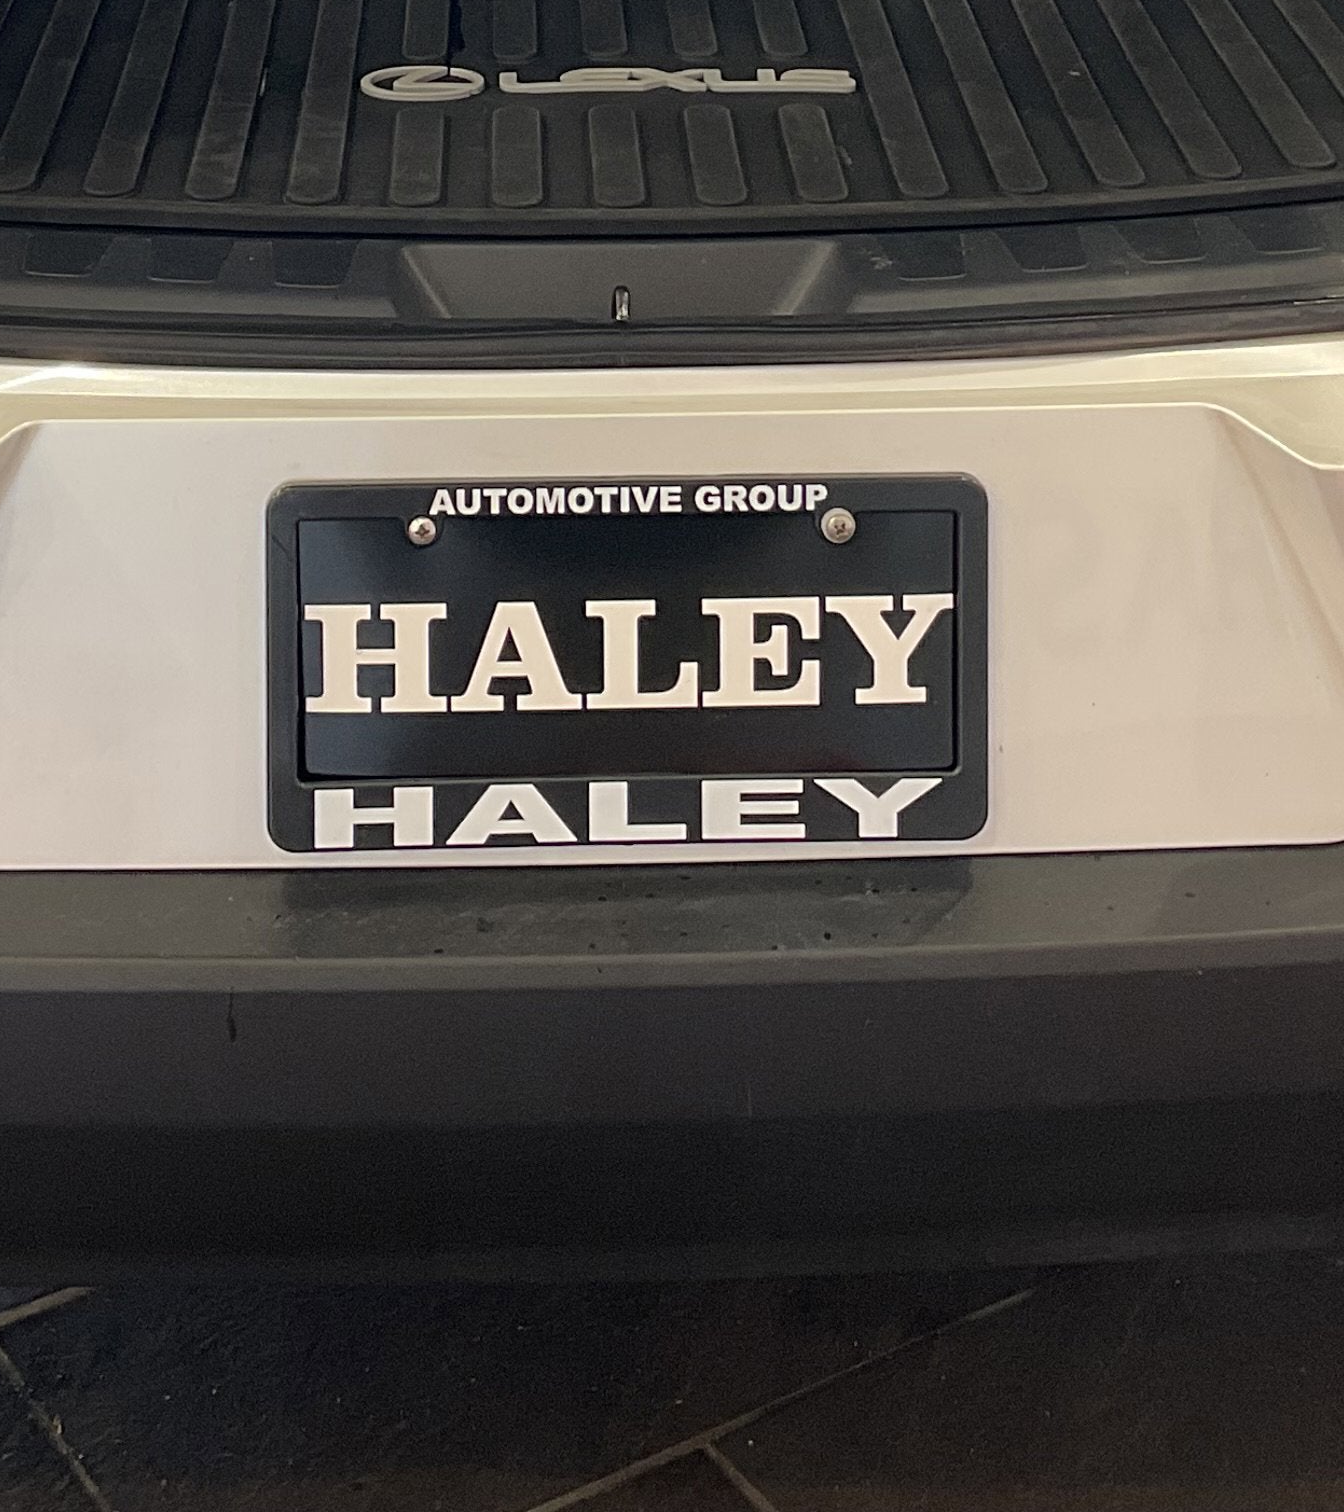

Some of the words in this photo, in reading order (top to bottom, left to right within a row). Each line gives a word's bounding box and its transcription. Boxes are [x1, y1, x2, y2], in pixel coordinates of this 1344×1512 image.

[498, 67, 857, 94] LEXUS
[429, 487, 683, 516] AUTOMOTIVE
[696, 484, 829, 513] GROUP
[303, 593, 955, 714] HALEY
[313, 778, 944, 849] HALEY
